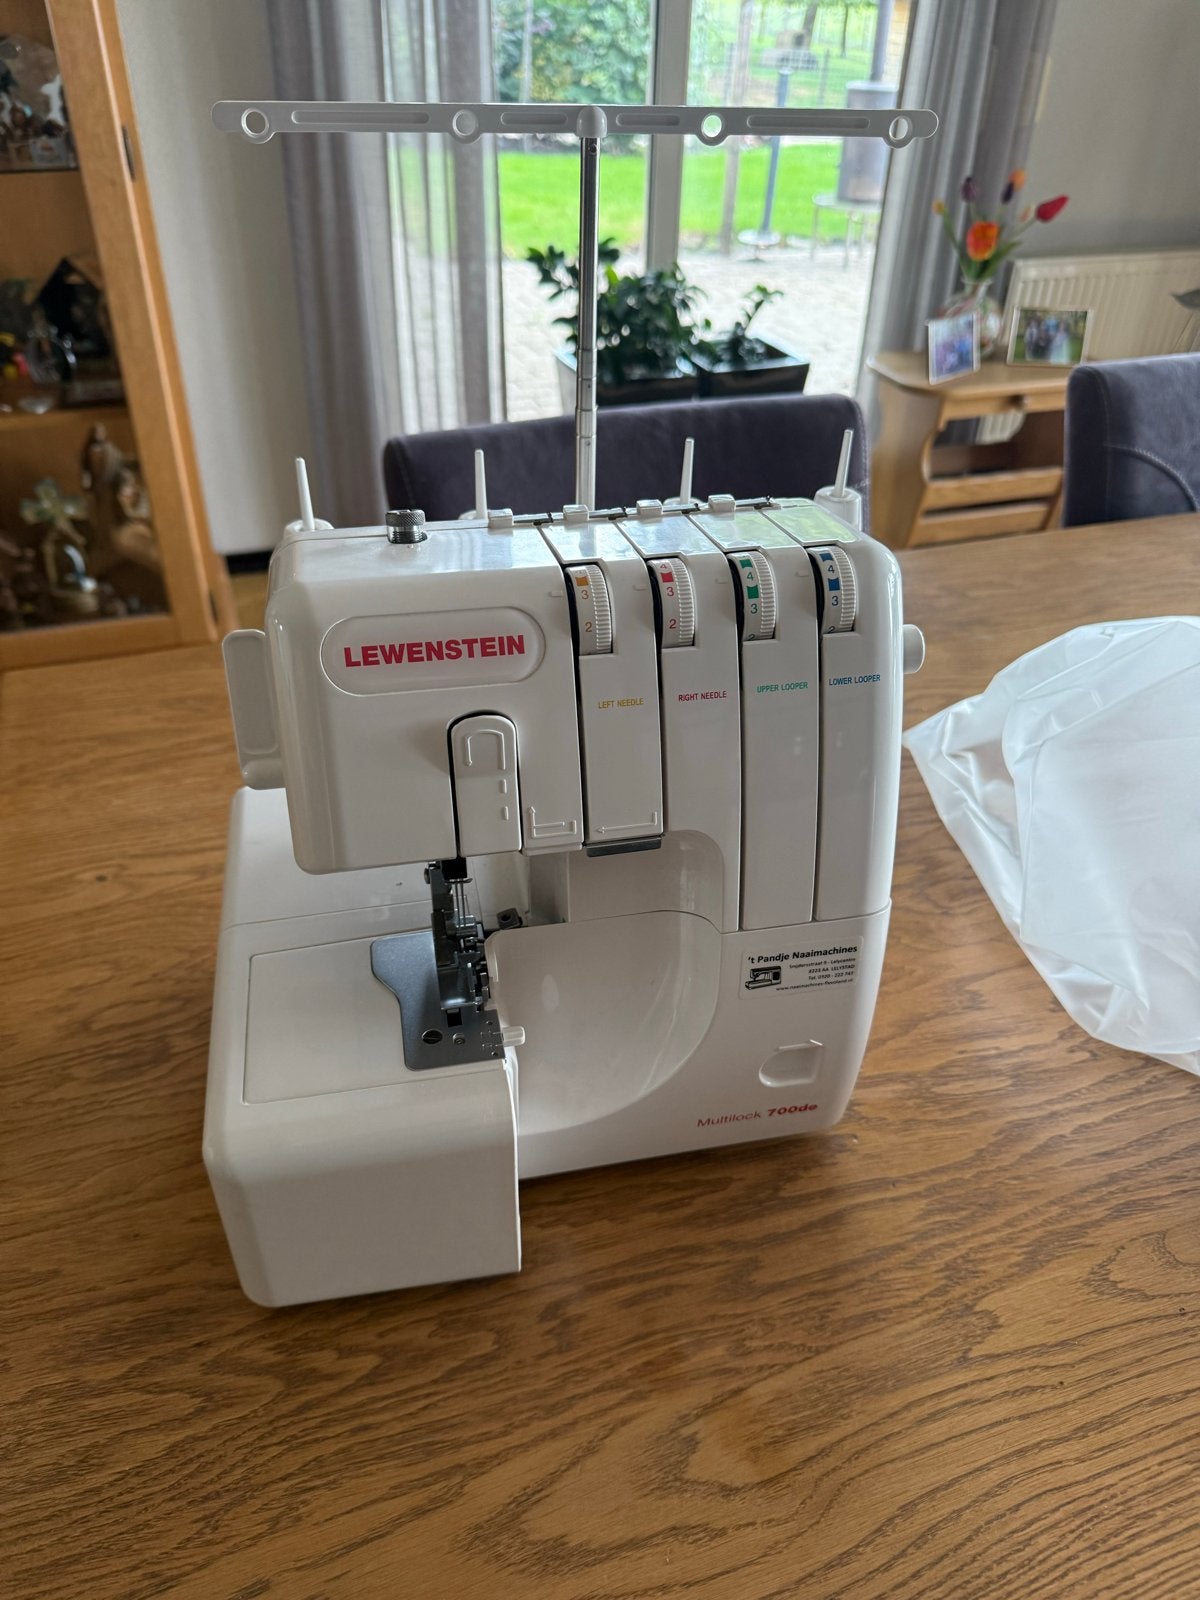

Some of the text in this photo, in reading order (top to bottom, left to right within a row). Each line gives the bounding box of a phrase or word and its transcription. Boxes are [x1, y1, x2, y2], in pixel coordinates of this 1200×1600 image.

[828, 565, 835, 574] 4
[746, 572, 754, 580] 4
[581, 590, 589, 600] 3
[666, 586, 674, 596] 3
[832, 596, 839, 606] 3
[750, 604, 758, 614] 3
[585, 622, 592, 632] 2
[669, 619, 676, 629] 2
[344, 634, 525, 668] LEWENSTEIN
[828, 674, 880, 686] LOWER LOOPER
[756, 682, 808, 693] UPPER LOOPER
[678, 690, 727, 702] RIGHT NEEDLE
[598, 698, 644, 709] LEFT NEEDLE
[758, 954, 789, 964] Pandje
[792, 946, 858, 959] Naaimachines
[696, 1104, 818, 1127] Multilock 700de
